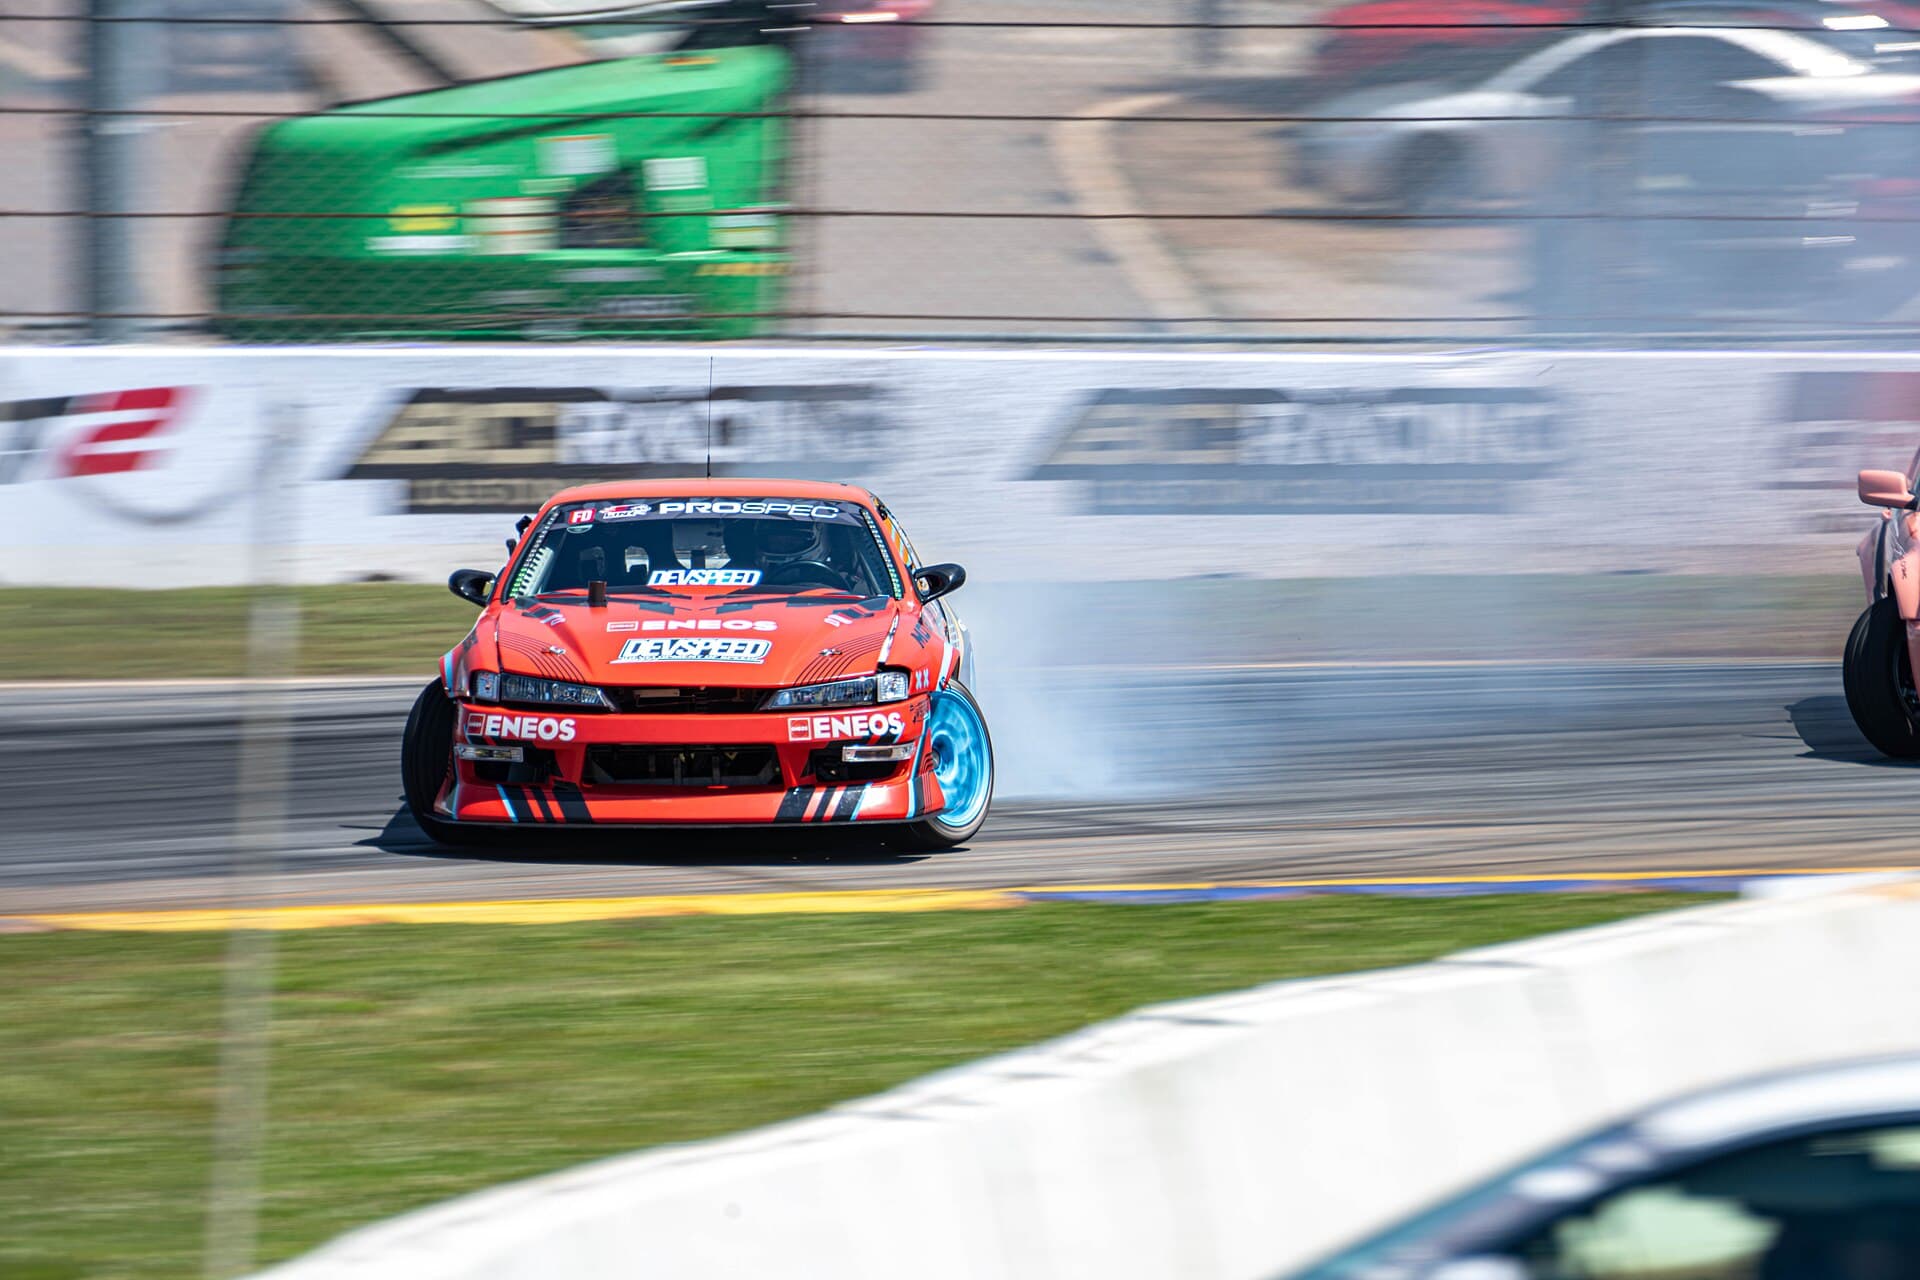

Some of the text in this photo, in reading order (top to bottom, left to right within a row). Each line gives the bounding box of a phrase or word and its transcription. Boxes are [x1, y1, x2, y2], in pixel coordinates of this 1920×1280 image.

[659, 502, 838, 519] PROSPEC
[647, 569, 762, 587] DEVSPEED
[641, 620, 778, 631] ENEOS
[620, 638, 772, 660] DEVSPEED
[485, 715, 576, 741] ENEOS
[813, 712, 903, 739] ENEOS
